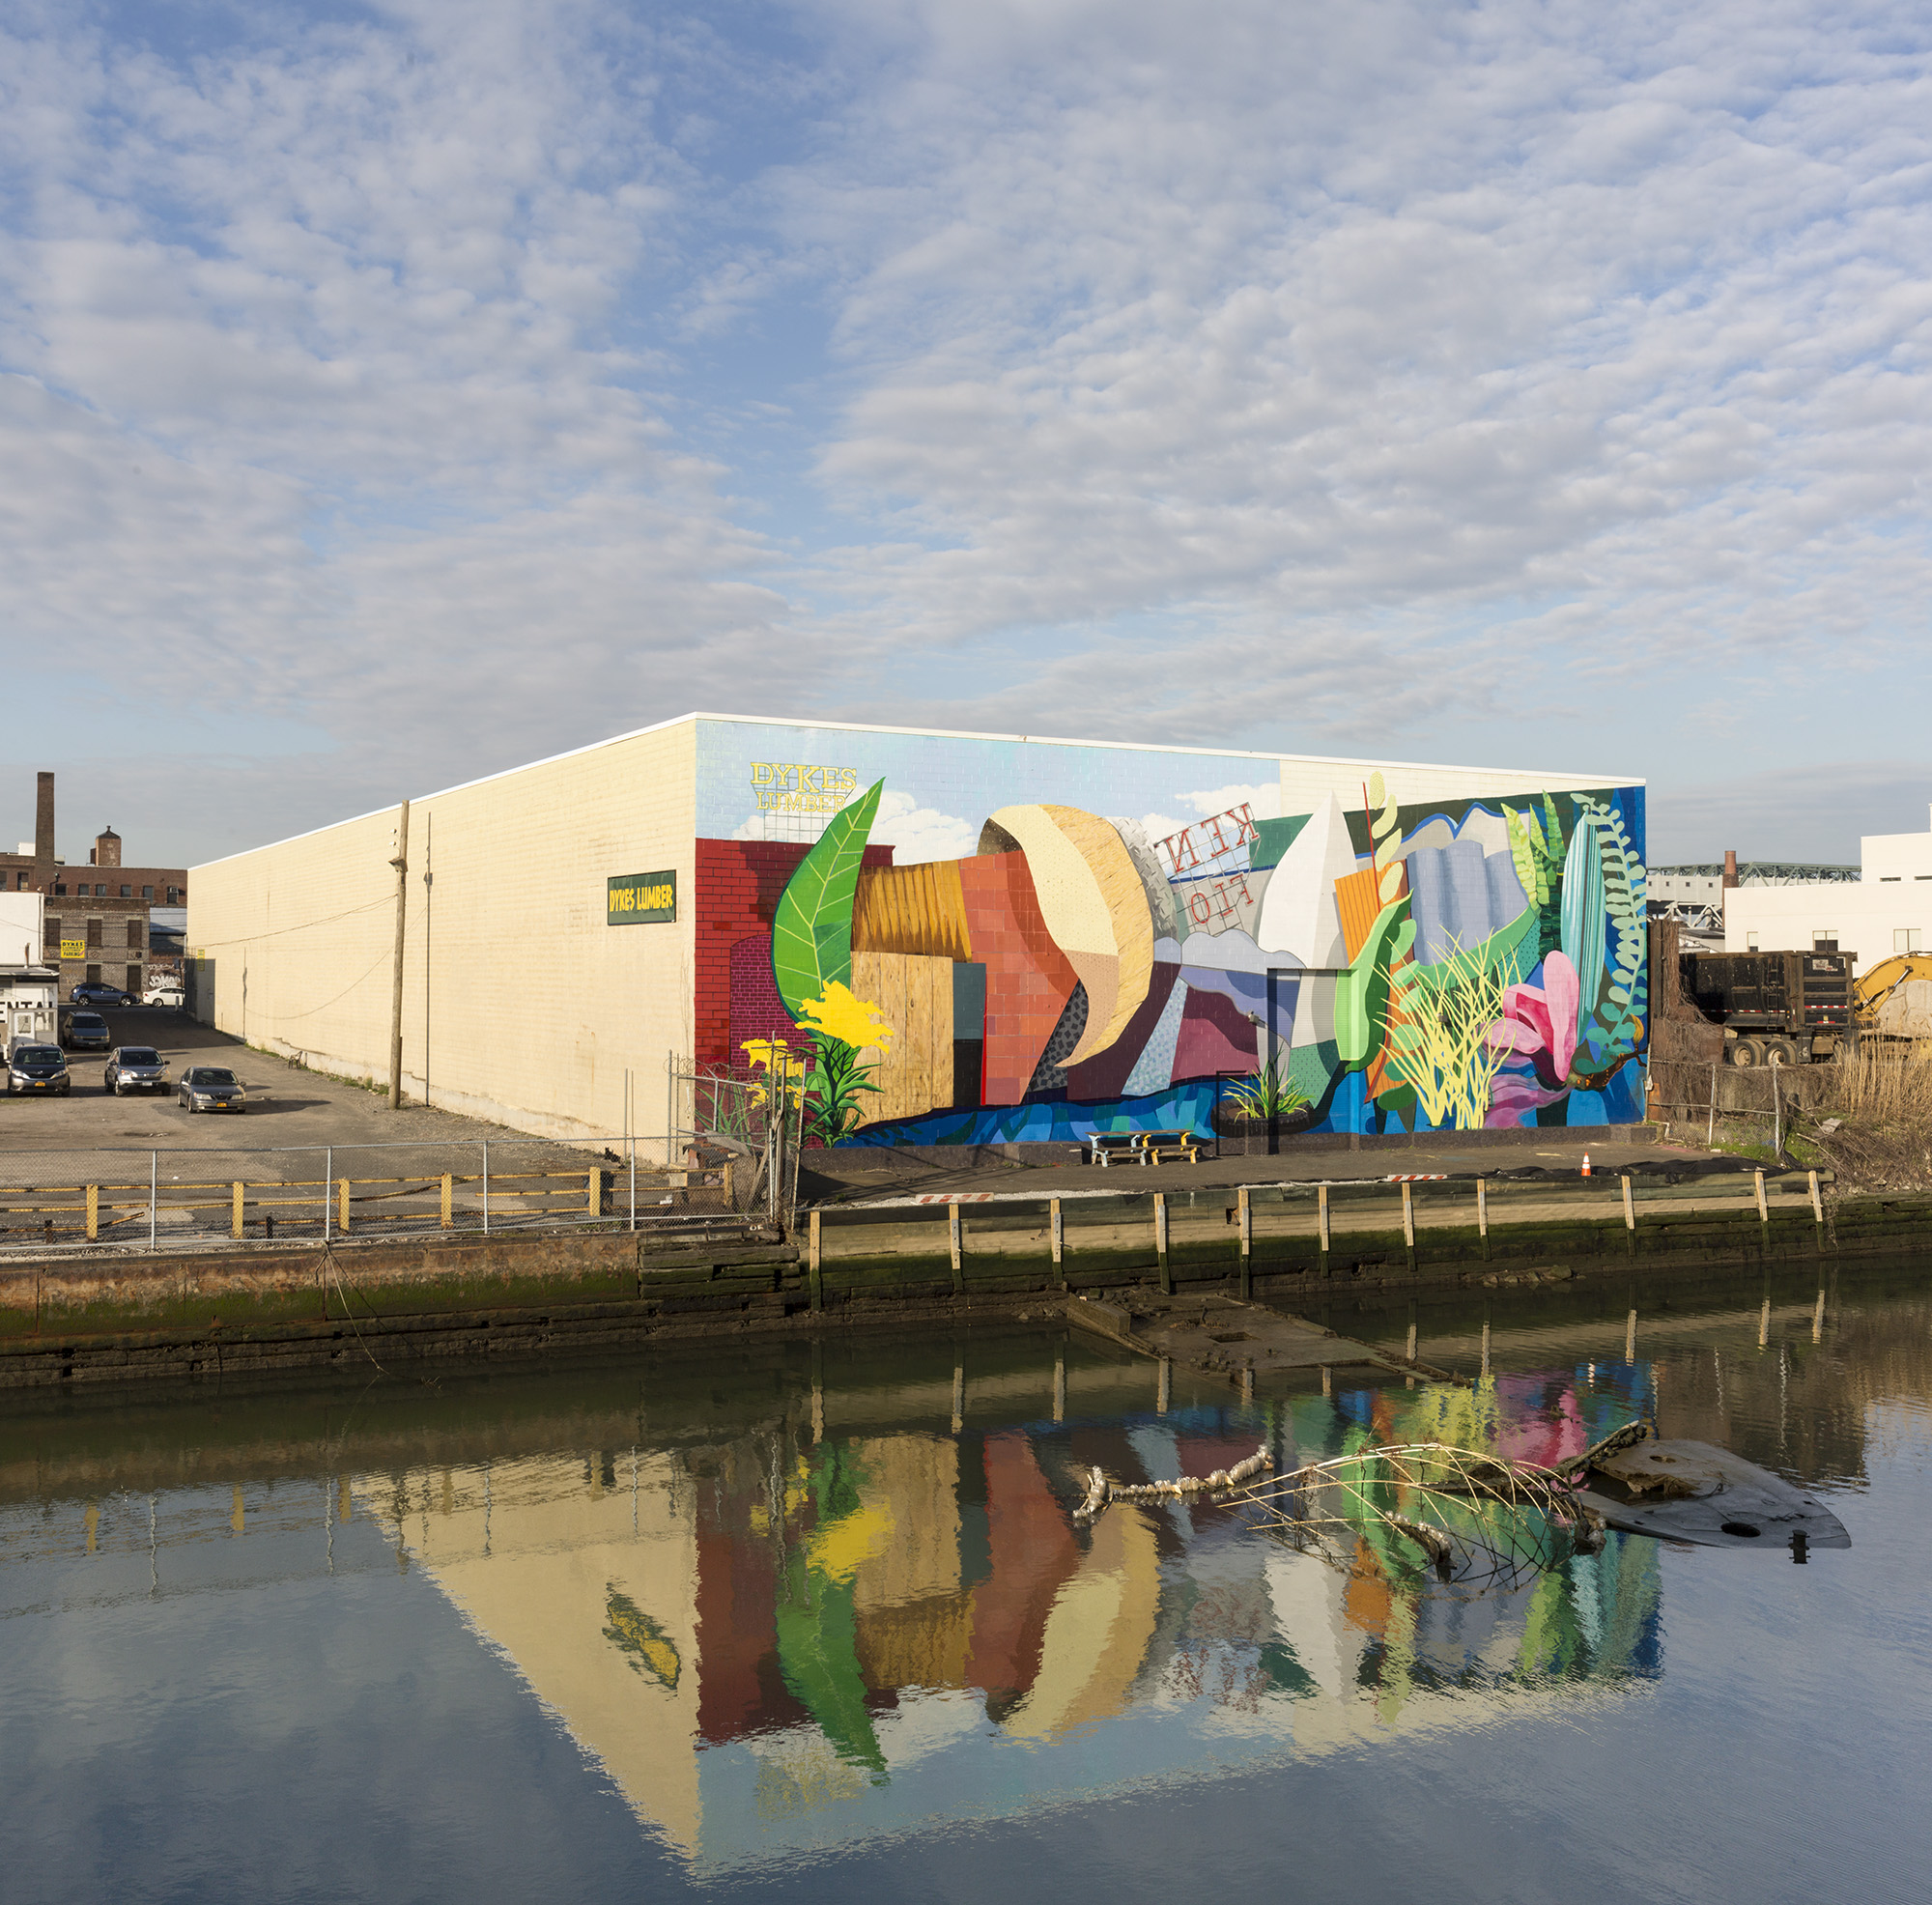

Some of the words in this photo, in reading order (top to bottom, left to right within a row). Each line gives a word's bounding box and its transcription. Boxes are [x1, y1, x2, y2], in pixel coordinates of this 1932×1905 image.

[751, 762, 856, 792] DYKES
[756, 791, 846, 812] LUMBER
[610, 888, 635, 912] DYKES
[637, 884, 673, 910] LUMBER
